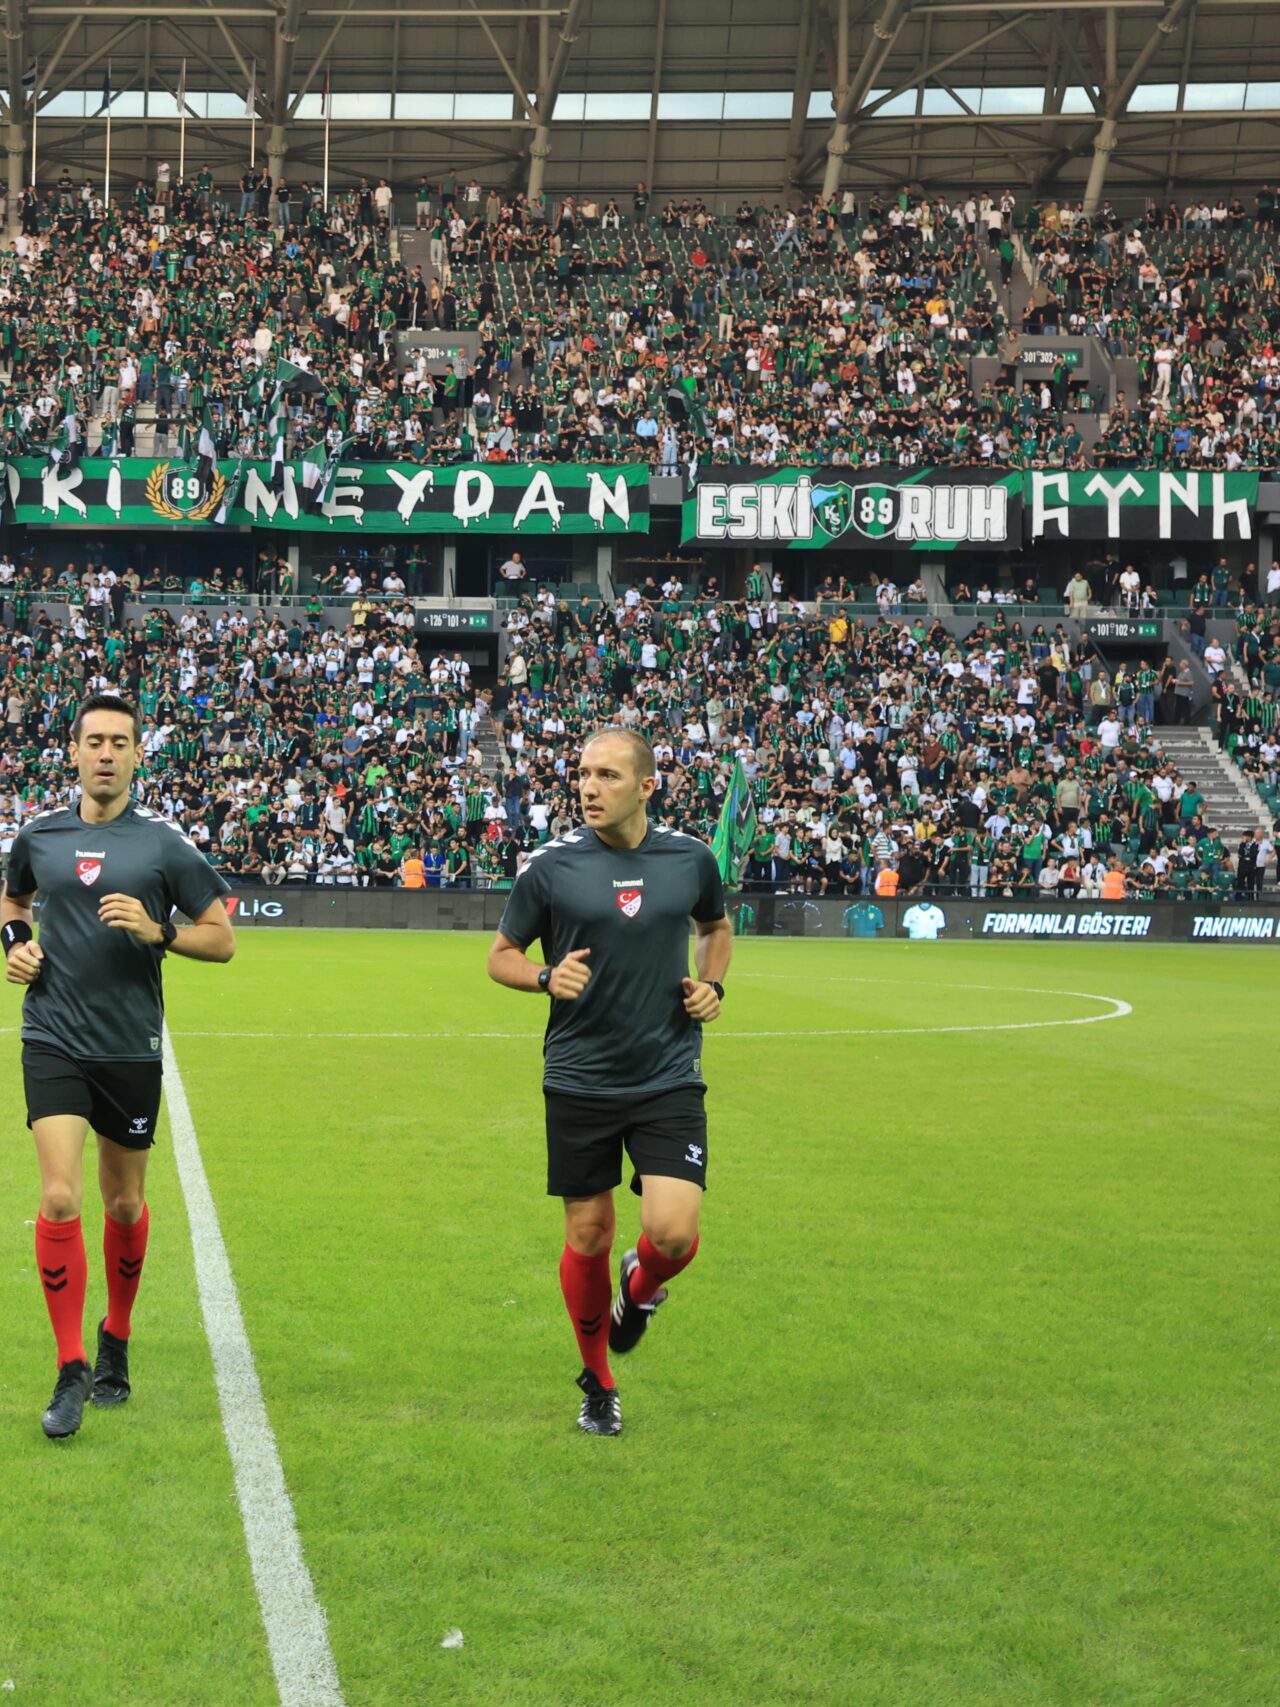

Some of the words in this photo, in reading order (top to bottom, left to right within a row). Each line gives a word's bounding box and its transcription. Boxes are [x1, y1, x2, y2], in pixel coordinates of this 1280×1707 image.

[1023, 351, 1036, 363] 301
[1040, 351, 1054, 363] 302
[171, 476, 200, 499] 89
[244, 465, 631, 532] MEYDAN
[696, 475, 813, 540] ESKİ
[860, 496, 894, 526] 89
[894, 485, 1008, 542] RUH
[429, 614, 443, 627] 126
[447, 614, 459, 627] 101
[1097, 624, 1110, 636] 101
[1115, 624, 1128, 636] 102
[239, 899, 284, 917] LİG
[982, 913, 1074, 935] FORMANLA
[1077, 911, 1152, 936] GÖSTER!
[1192, 916, 1271, 937] TAKIMINA
